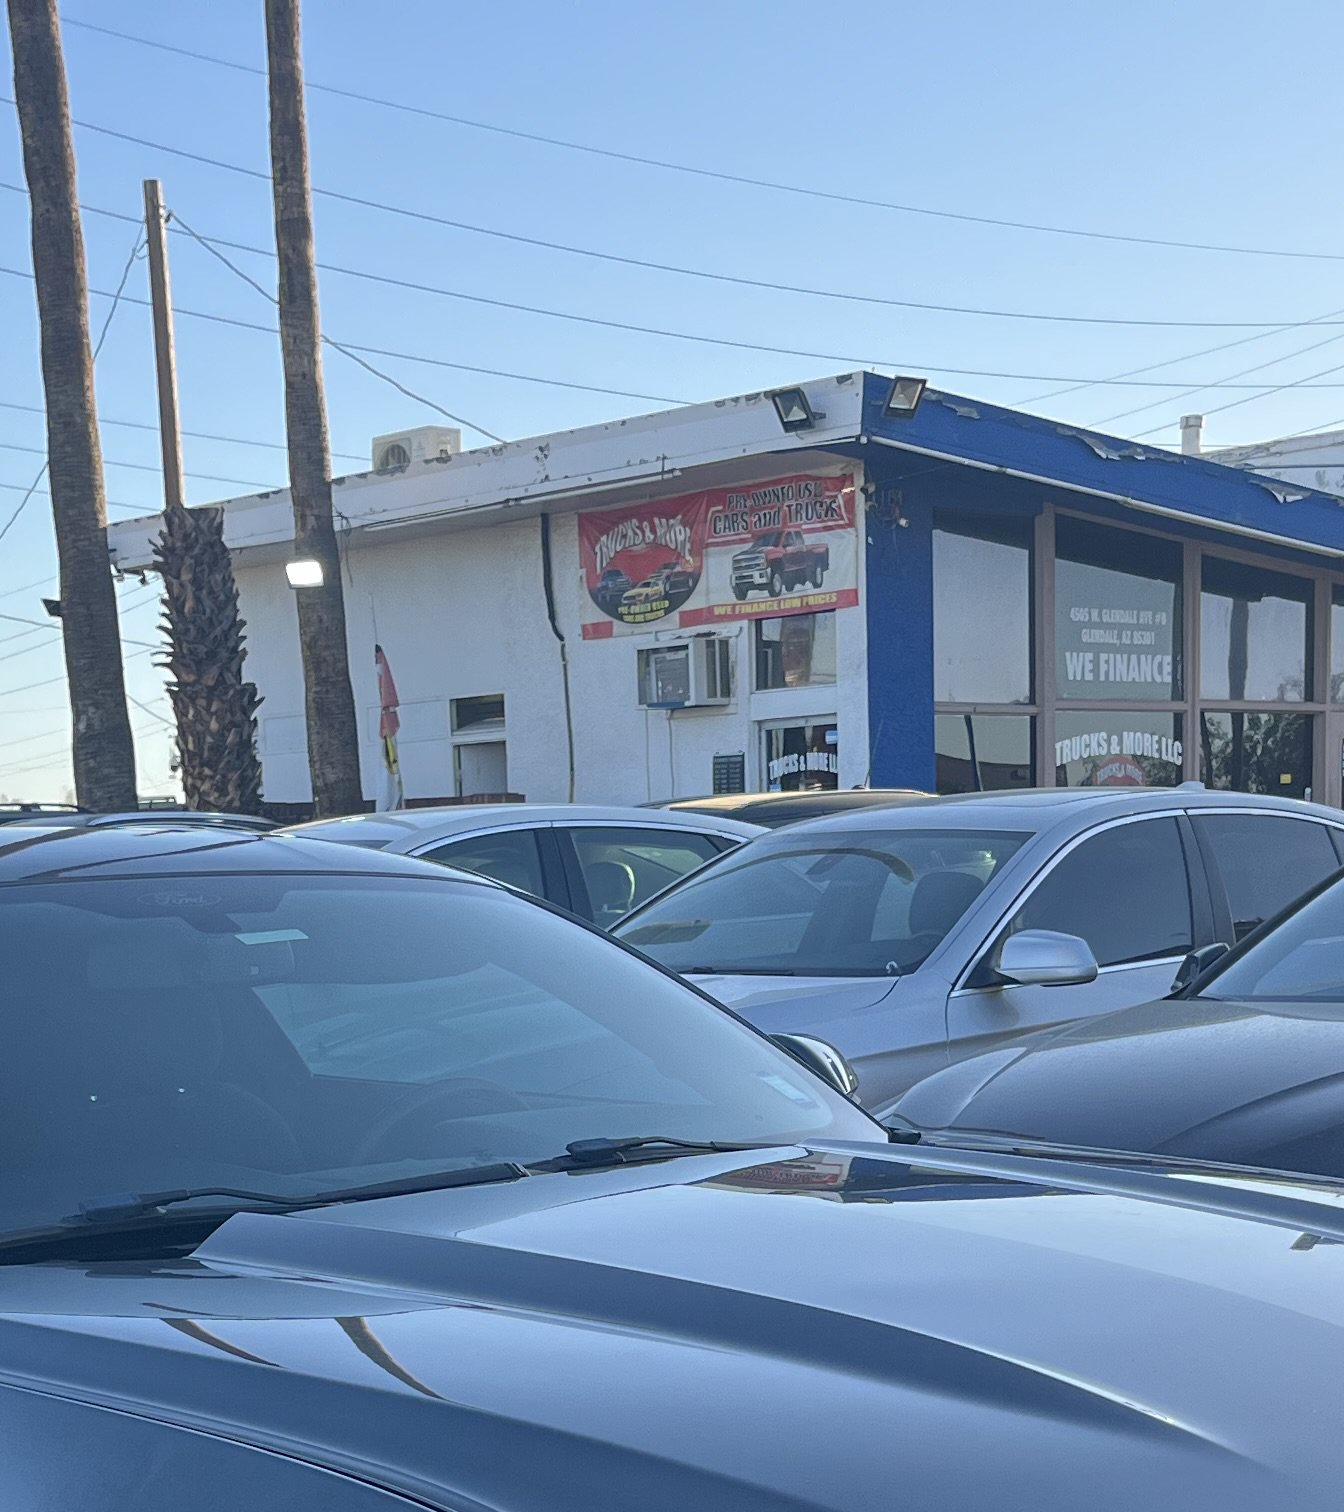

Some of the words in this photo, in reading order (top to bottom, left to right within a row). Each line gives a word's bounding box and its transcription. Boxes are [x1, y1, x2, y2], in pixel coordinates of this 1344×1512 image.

[727, 483, 795, 511] PRE-OWNED
[712, 510, 750, 536] CARS
[752, 507, 782, 530] and
[594, 518, 643, 575] TRUCKS
[642, 520, 655, 543] &
[653, 515, 694, 565] MORE
[713, 605, 733, 616] WE
[735, 600, 778, 614] FINANCE
[780, 597, 801, 609] LOW
[802, 592, 838, 607] PRICES
[1101, 609, 1138, 624] GLENDALE
[1064, 651, 1094, 681] WE
[1099, 652, 1172, 683] FINANCE
[1054, 731, 1108, 767] TRUCKS
[1110, 734, 1120, 755] &
[1122, 731, 1159, 759] MORE
[1161, 736, 1183, 766] LLC
